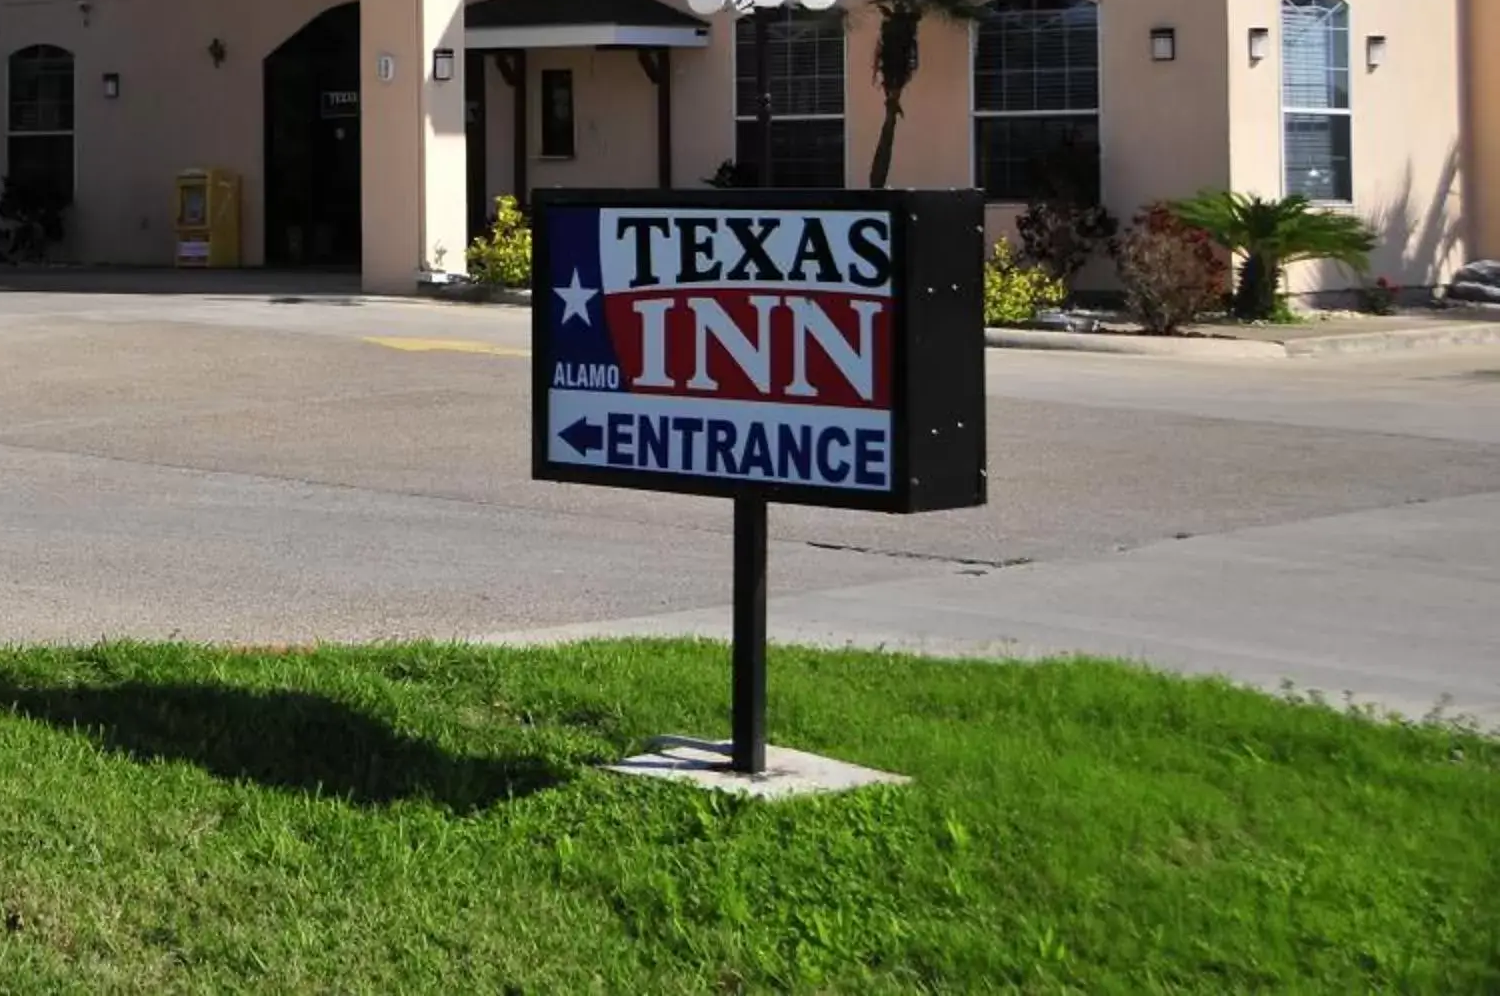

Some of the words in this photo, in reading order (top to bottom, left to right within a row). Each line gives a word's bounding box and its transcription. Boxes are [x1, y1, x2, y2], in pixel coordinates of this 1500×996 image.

[616, 216, 891, 288] TEXAS
[553, 361, 620, 390] ALAMO
[632, 294, 884, 401] INN
[606, 412, 886, 485] ENTRANCE
